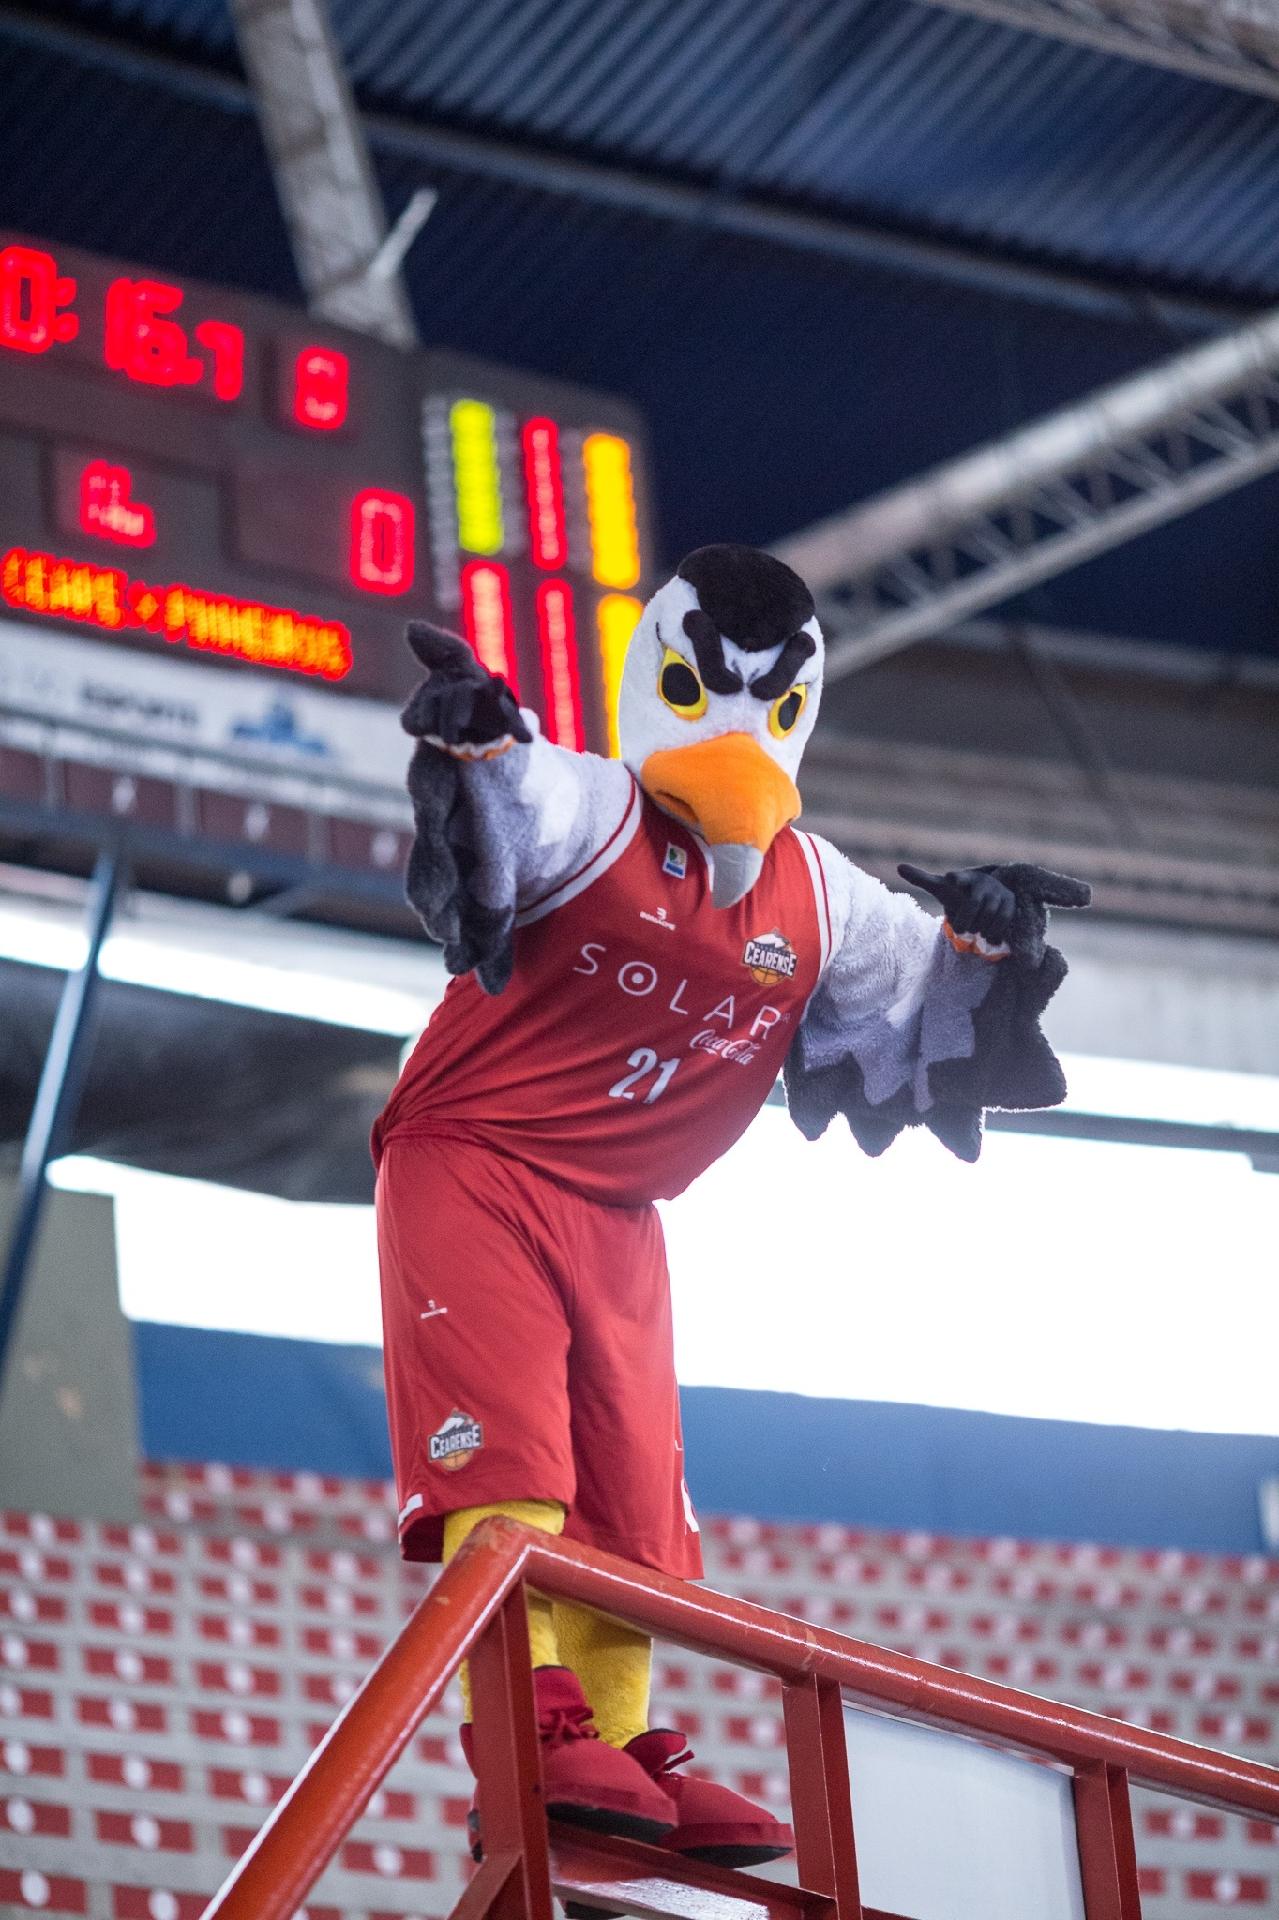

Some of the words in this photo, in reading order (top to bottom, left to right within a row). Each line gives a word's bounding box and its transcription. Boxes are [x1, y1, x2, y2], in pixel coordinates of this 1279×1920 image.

[351, 488, 415, 595] 0
[573, 943, 782, 1041] SOLAR
[744, 941, 797, 976] CEARENSE
[608, 1047, 681, 1104] 21
